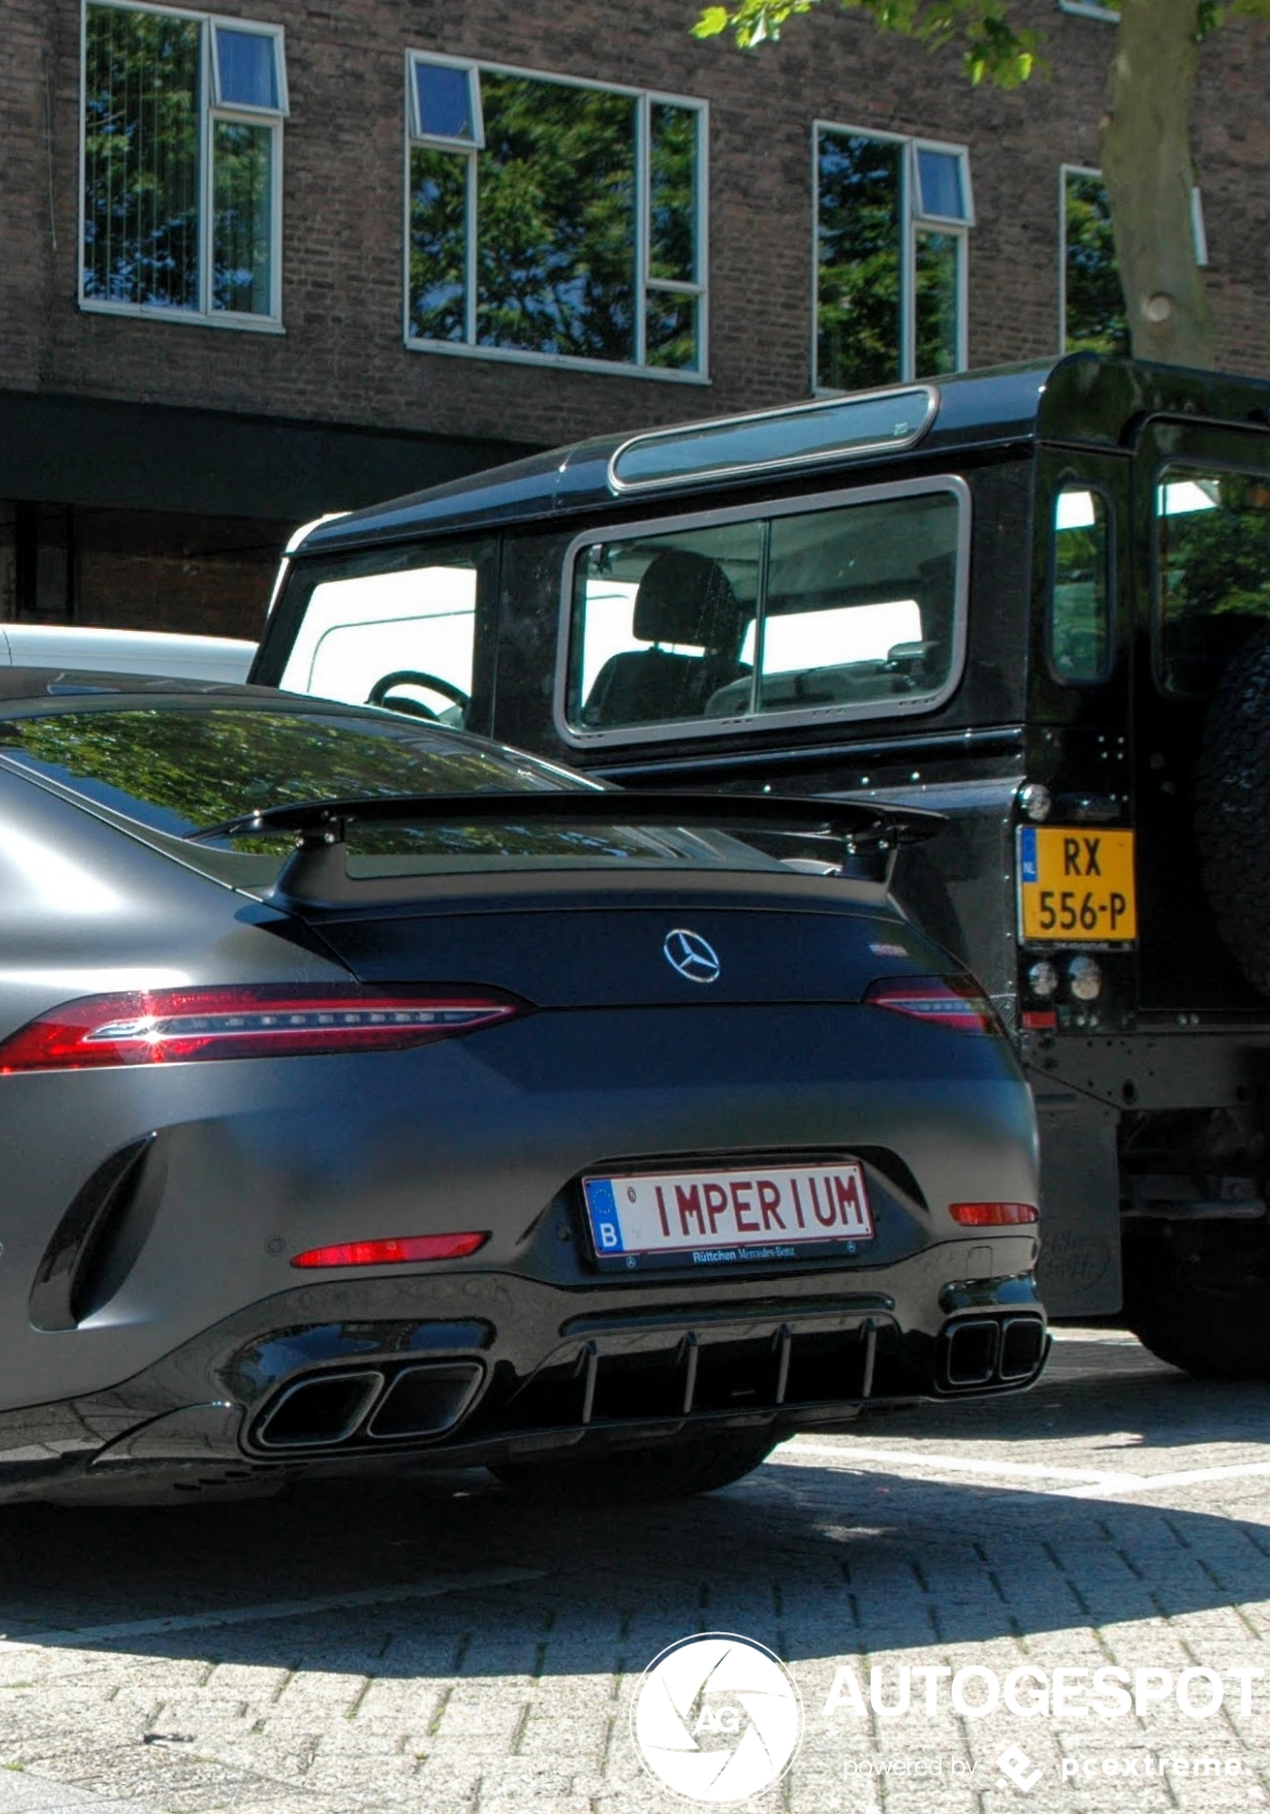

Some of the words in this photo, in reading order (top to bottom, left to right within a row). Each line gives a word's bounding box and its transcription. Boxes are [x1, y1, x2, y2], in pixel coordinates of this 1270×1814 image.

[1063, 837, 1101, 876] RX
[1039, 890, 1127, 931] 556-P
[655, 1175, 864, 1237] IMPERIUM
[599, 1222, 618, 1247] B
[692, 1249, 737, 1263] Rüttchen
